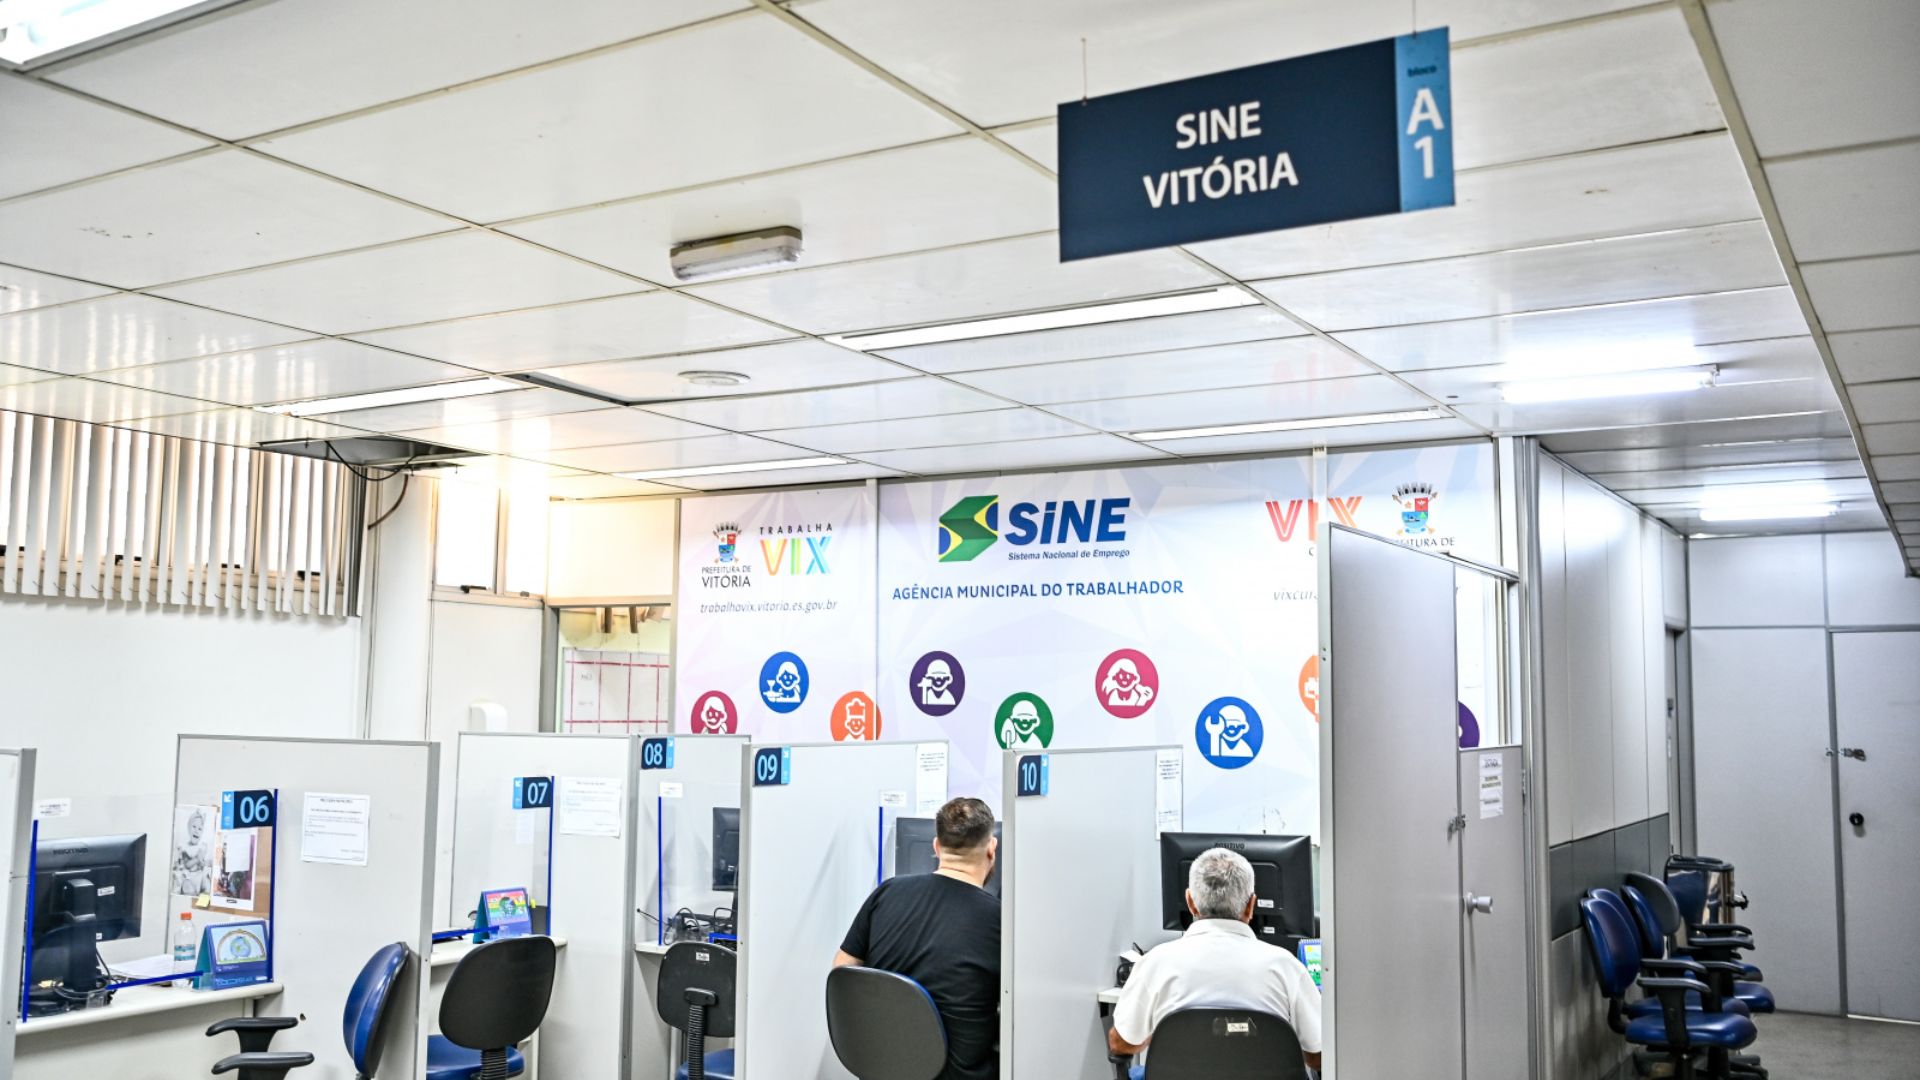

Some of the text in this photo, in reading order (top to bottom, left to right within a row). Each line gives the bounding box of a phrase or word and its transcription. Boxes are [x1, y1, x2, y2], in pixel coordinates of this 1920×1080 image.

[1407, 64, 1438, 77] bloco
[1406, 88, 1444, 135] A
[1176, 101, 1262, 149] SINE
[1414, 136, 1434, 180] 1
[1143, 152, 1299, 209] VITÓRIA
[760, 523, 832, 535] TRABALHA
[1440, 537, 1455, 546] DE
[759, 536, 832, 576] VIX
[1008, 548, 1130, 560] Sistema Nacional de Emprego
[701, 565, 751, 574] PREFEITURA DE
[892, 580, 1184, 600] AGÊNCIA MUNICIPAL DO TRABALHADOR
[700, 599, 837, 614] trabalhavix.vitoria.es.gov.br
[644, 743, 663, 765] 08
[757, 754, 778, 781] 09
[1022, 762, 1037, 791] 10
[528, 782, 548, 805] 07
[240, 795, 270, 824] 06
